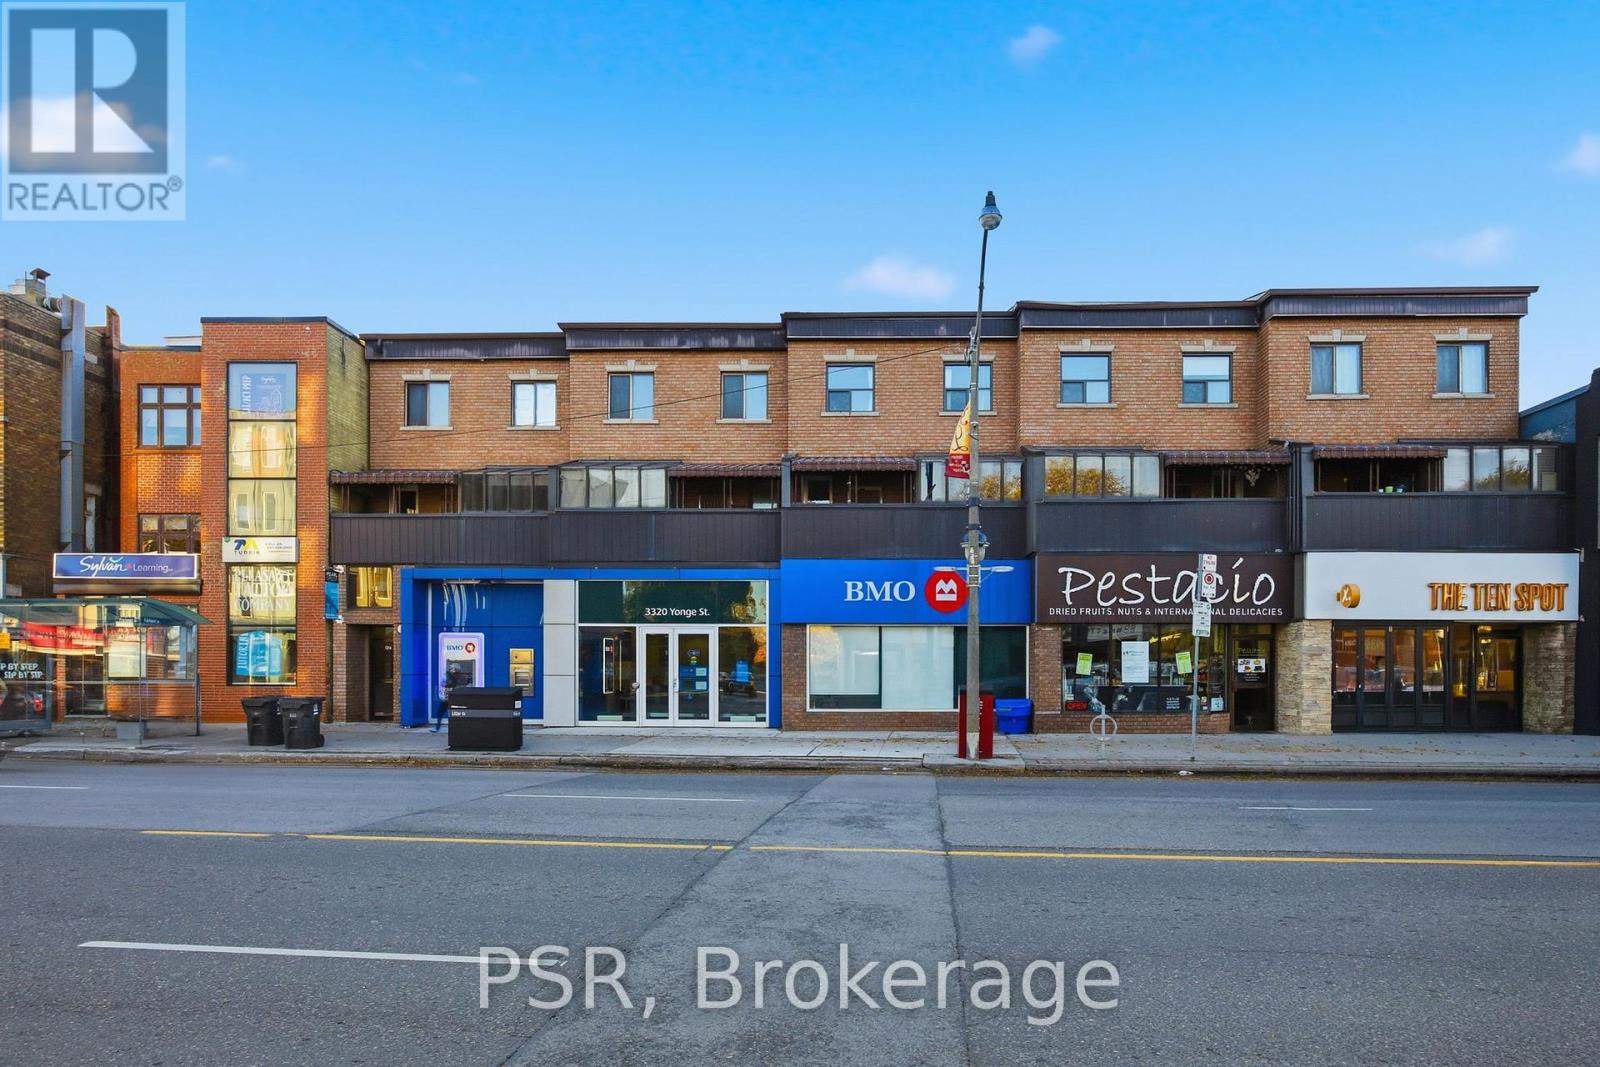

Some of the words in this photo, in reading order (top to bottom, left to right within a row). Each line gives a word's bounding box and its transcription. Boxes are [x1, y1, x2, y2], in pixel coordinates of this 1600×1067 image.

[79, 556, 128, 577] Sylvan
[133, 563, 169, 573] Learning
[844, 580, 916, 601] BMO
[1427, 583, 1468, 611] THE
[1470, 583, 1511, 611] TEN
[1514, 583, 1569, 611] SPOT
[645, 608, 668, 616] 3320
[669, 608, 697, 618] Yonge
[698, 608, 710, 616] St.
[1049, 608, 1077, 616] DRIED
[1118, 608, 1142, 616] NUTS
[1145, 608, 1151, 616] &
[1154, 608, 1226, 616] INTERNANAL
[1229, 608, 1283, 616] DELICACIES
